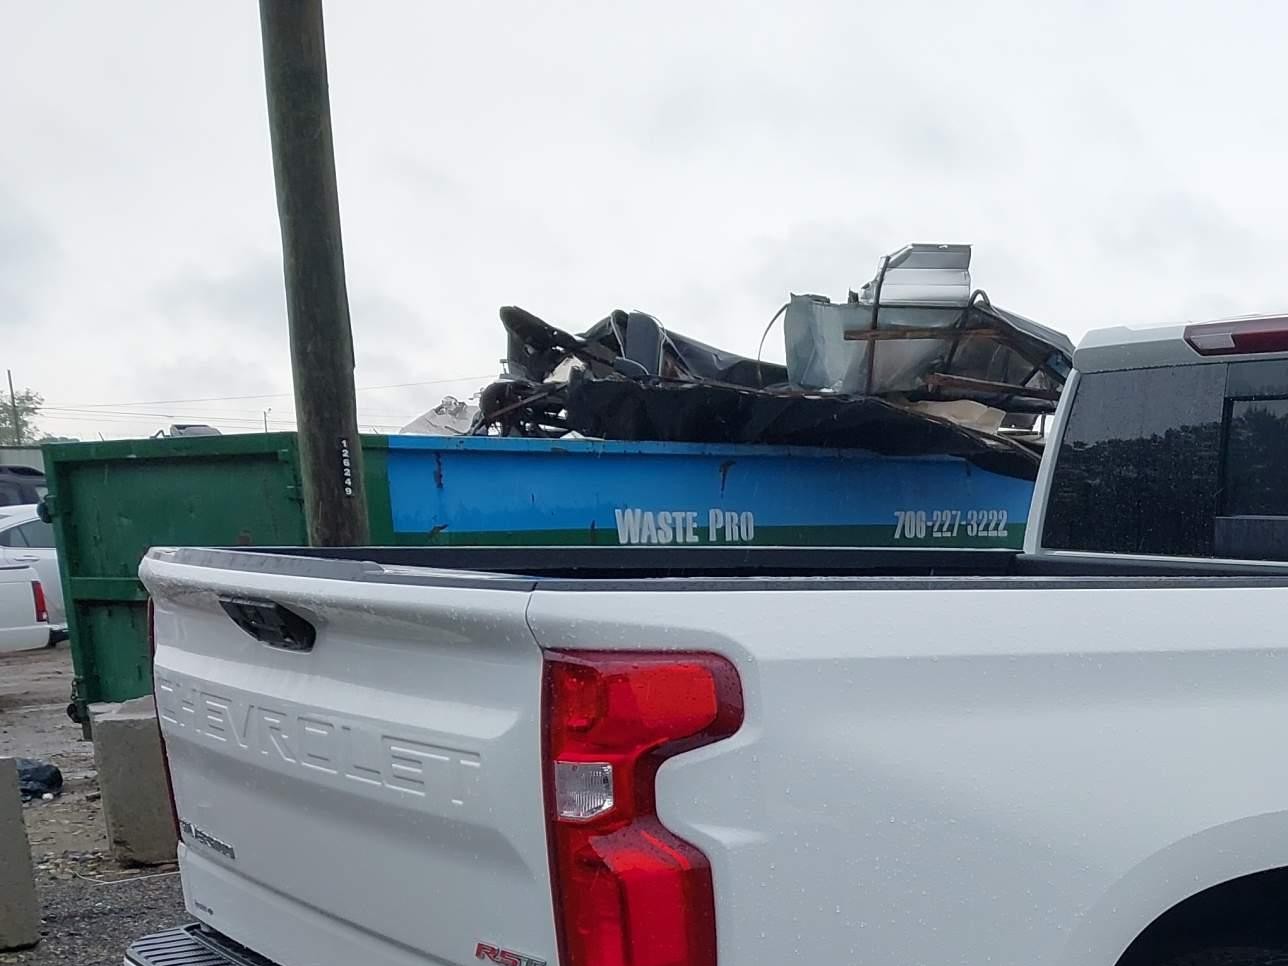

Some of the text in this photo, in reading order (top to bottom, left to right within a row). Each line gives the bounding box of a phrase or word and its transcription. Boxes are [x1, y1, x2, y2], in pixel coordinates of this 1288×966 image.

[340, 439, 352, 496] 126249
[614, 508, 754, 544] WASTE PRO
[894, 510, 1008, 539] 706-227-3222
[157, 677, 481, 806] CHEVROLET
